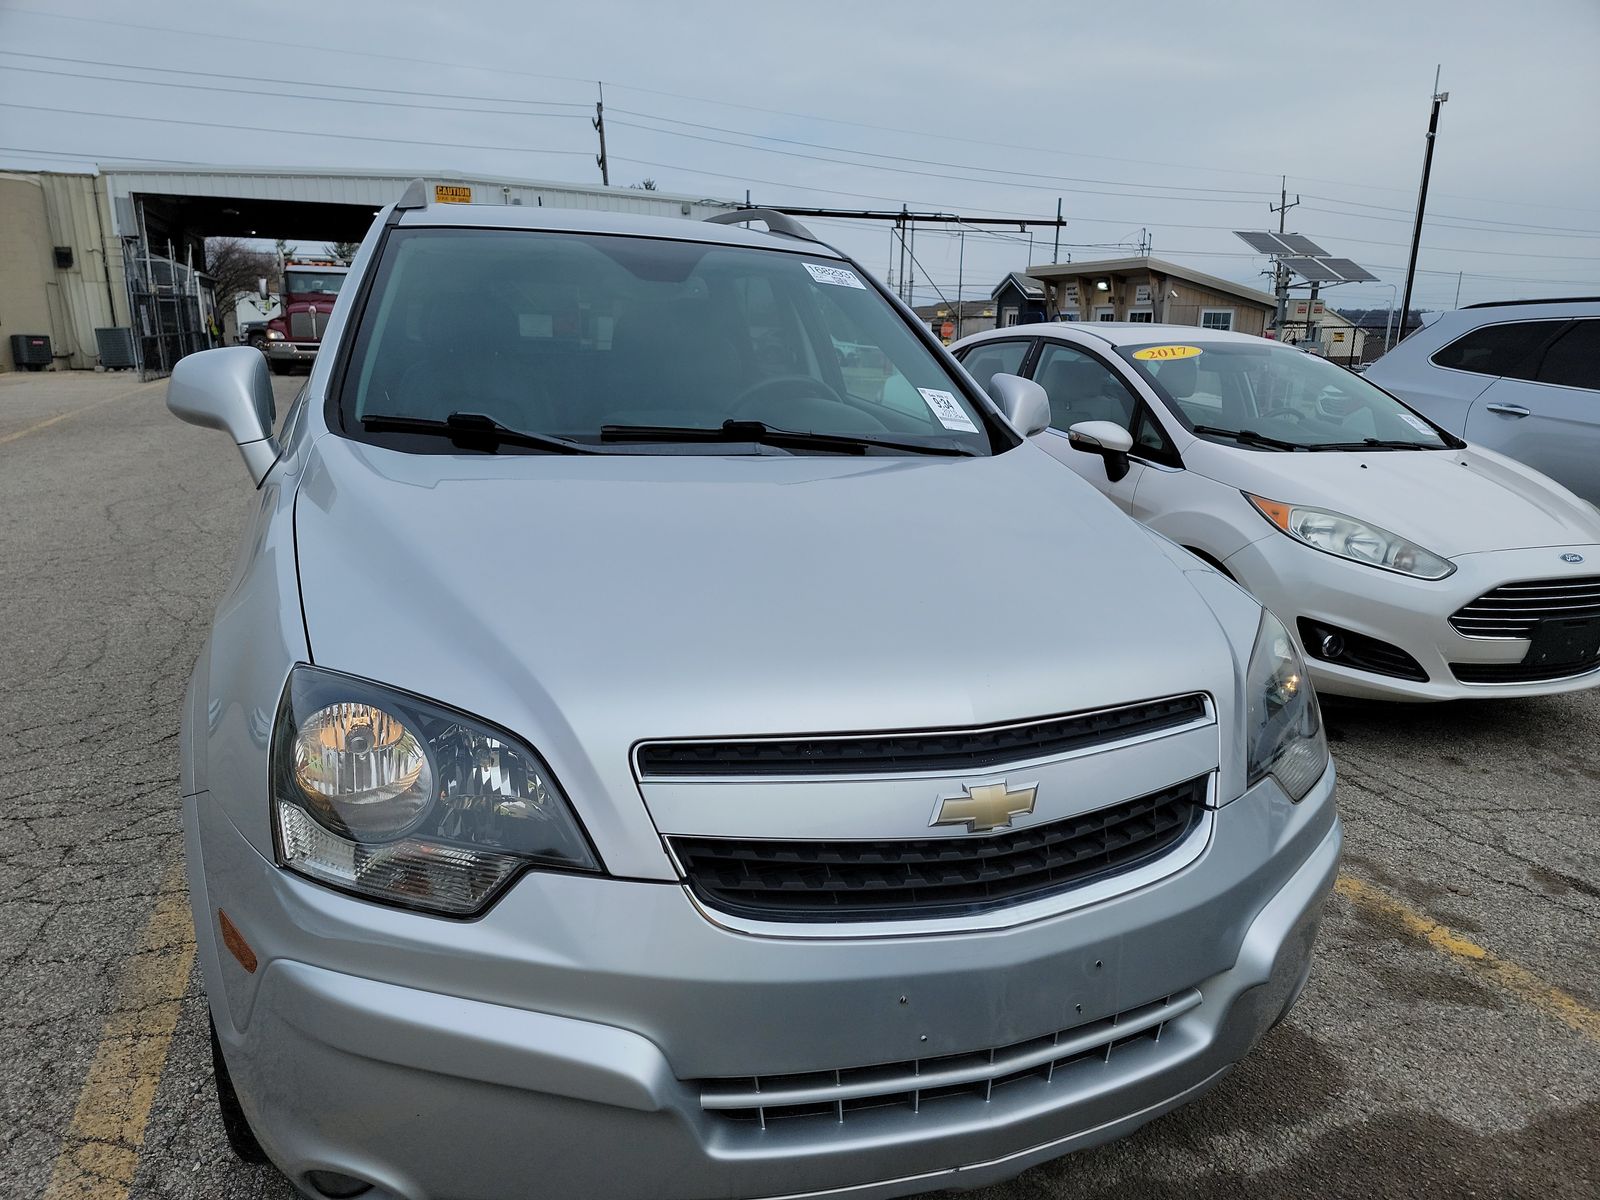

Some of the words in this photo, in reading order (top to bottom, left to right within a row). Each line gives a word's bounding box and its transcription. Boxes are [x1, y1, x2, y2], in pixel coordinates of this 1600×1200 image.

[437, 186, 470, 196] CAUTION
[808, 265, 857, 280] 1682931
[1146, 347, 1186, 359] 2017
